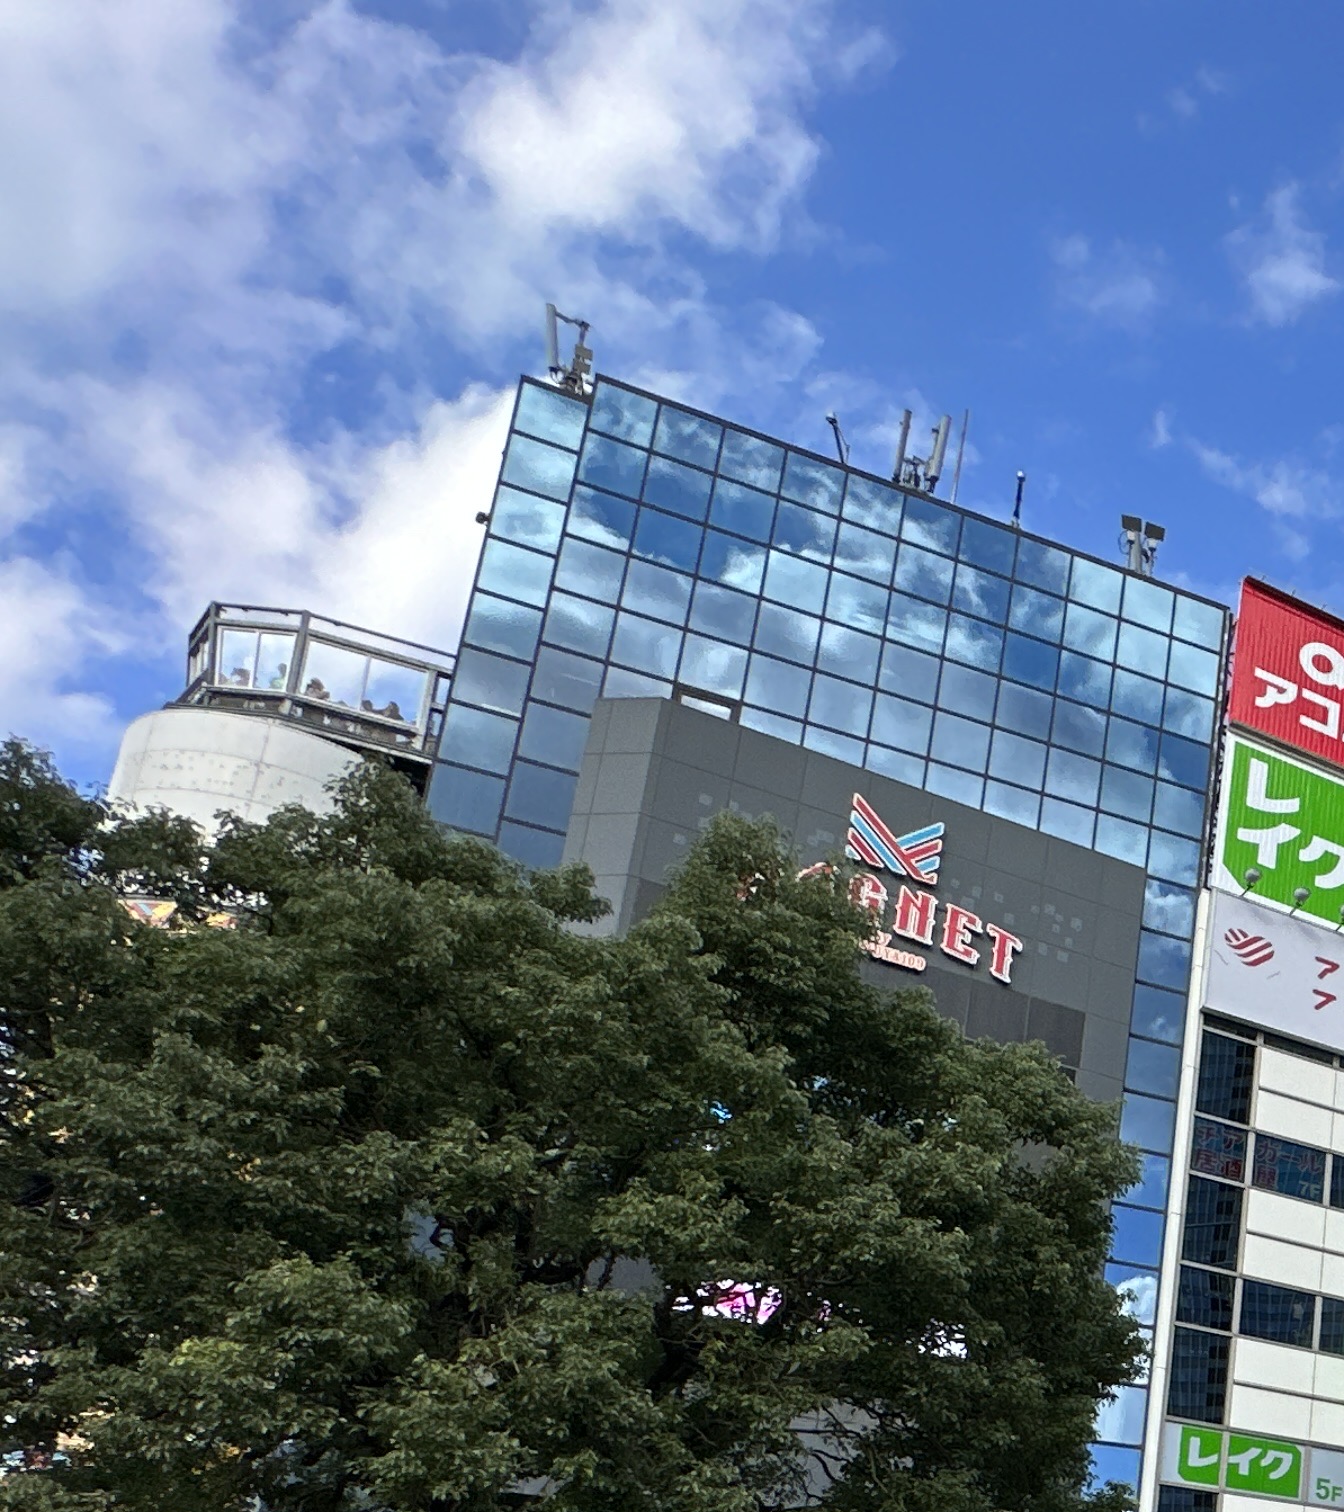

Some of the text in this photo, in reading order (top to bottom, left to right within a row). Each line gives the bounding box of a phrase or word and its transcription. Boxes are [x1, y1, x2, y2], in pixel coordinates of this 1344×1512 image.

[1187, 1436, 1293, 1480] レイク
[1315, 1477, 1344, 1502] 5F
